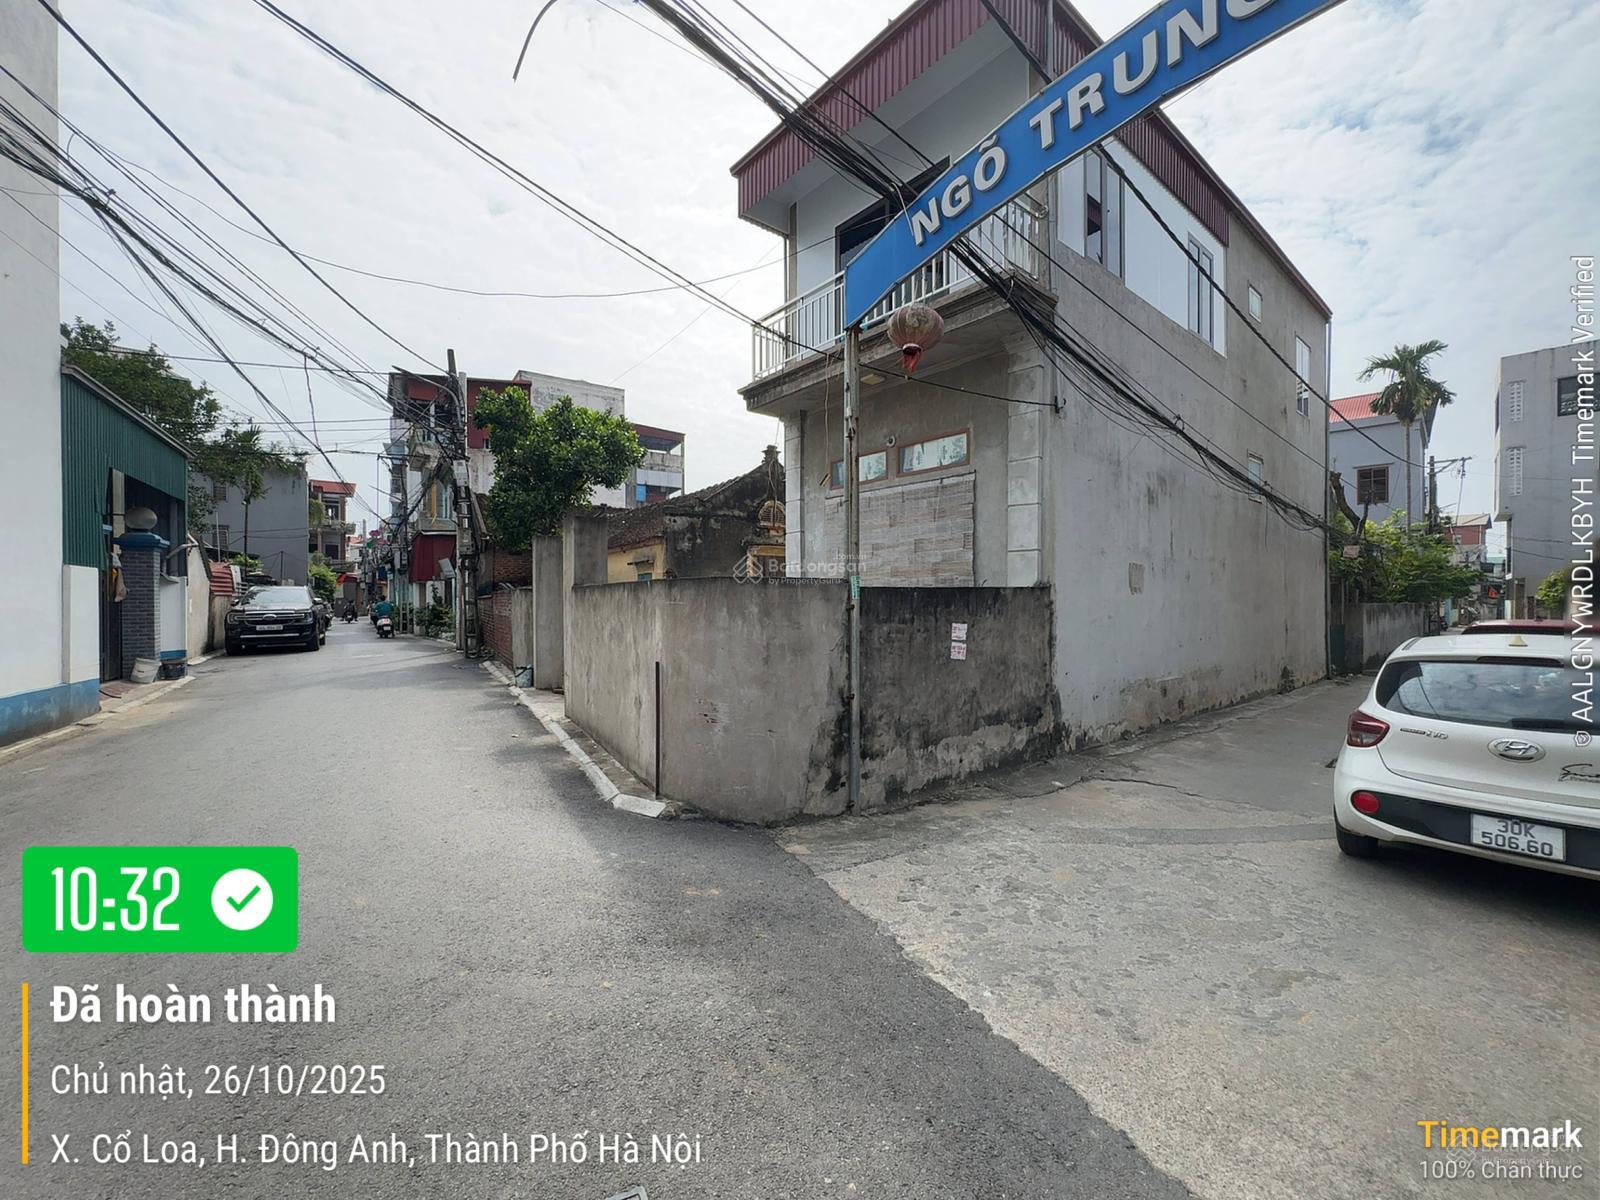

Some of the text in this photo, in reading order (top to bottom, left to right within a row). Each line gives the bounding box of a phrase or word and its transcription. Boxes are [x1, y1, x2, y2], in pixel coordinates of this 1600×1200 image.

[910, 133, 1009, 248] NGÕ
[1497, 819, 1536, 839] 30K
[1481, 831, 1554, 857] 506.60
